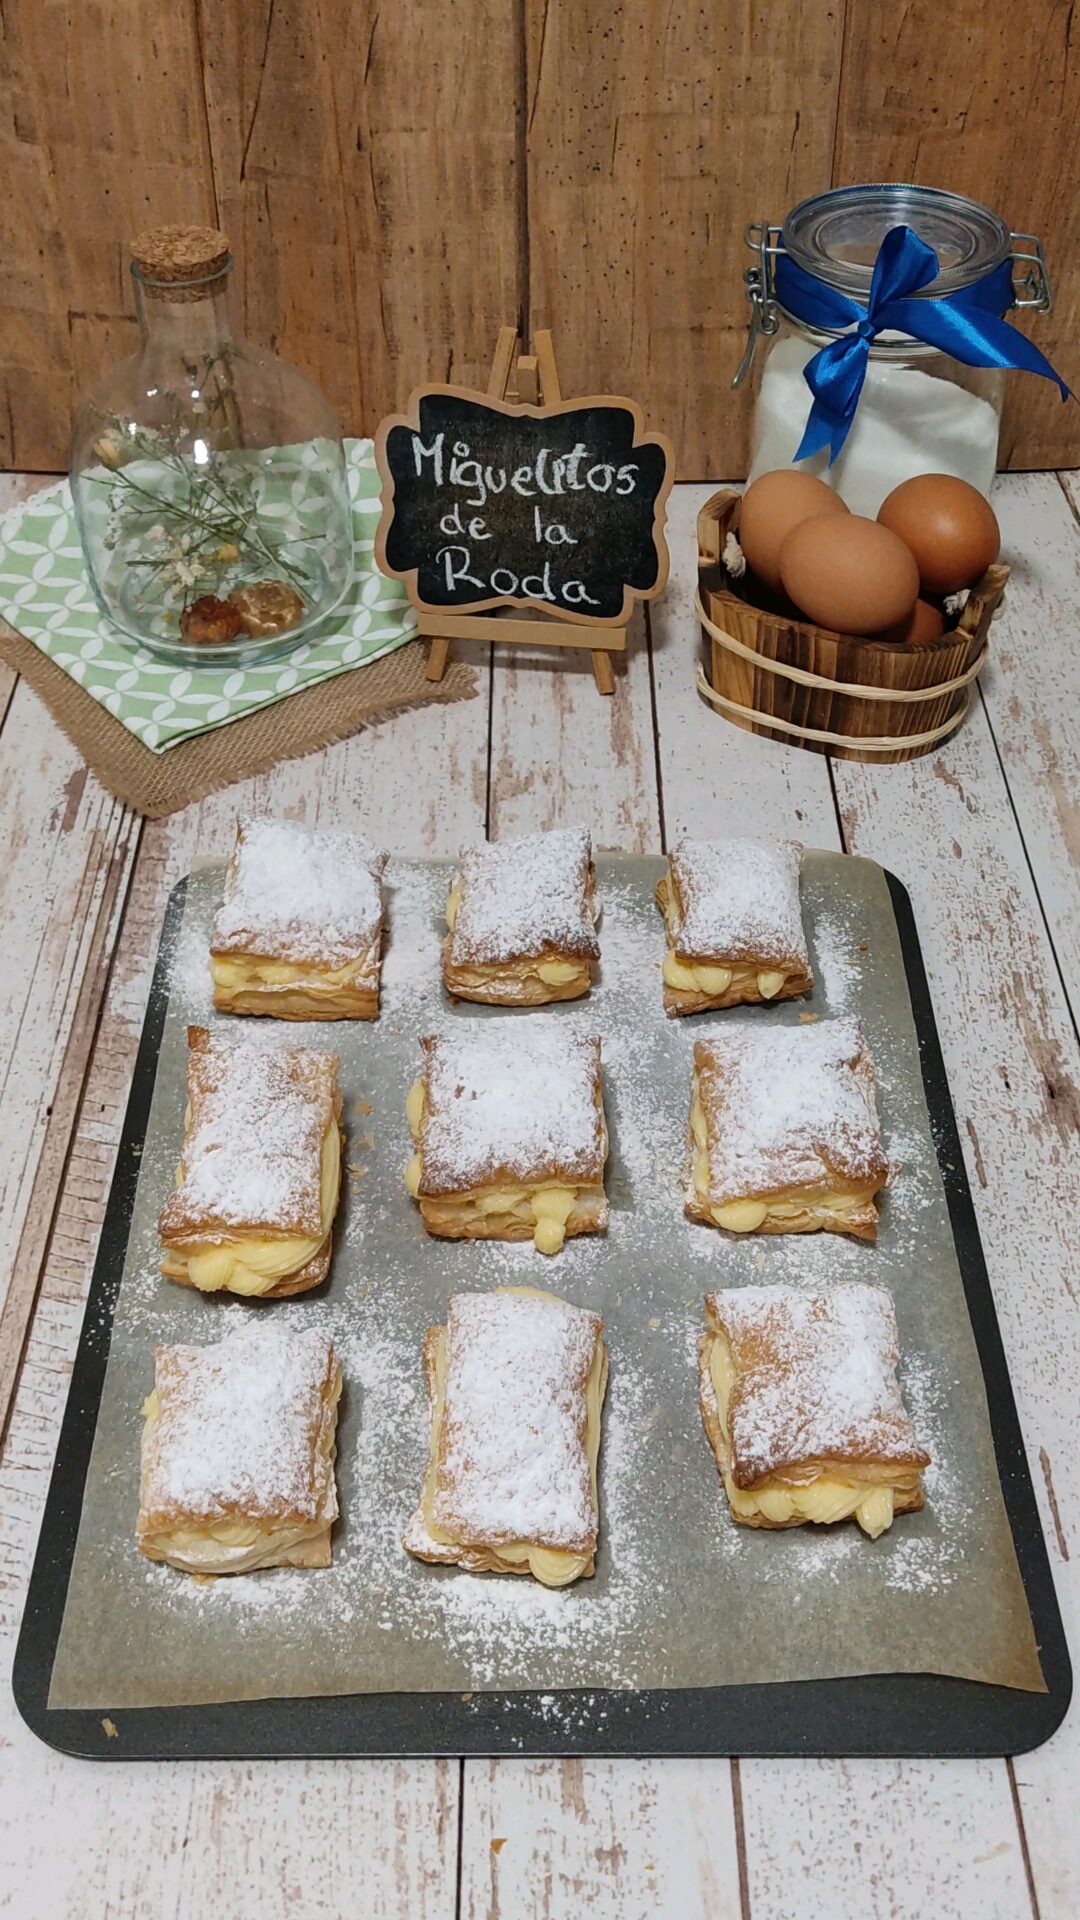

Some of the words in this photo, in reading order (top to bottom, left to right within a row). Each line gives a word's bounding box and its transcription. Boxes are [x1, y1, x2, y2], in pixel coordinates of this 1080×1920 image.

[411, 432, 640, 506] Miguelitos
[439, 503, 493, 540] de
[534, 505, 578, 545] la
[435, 545, 601, 604] Roda
